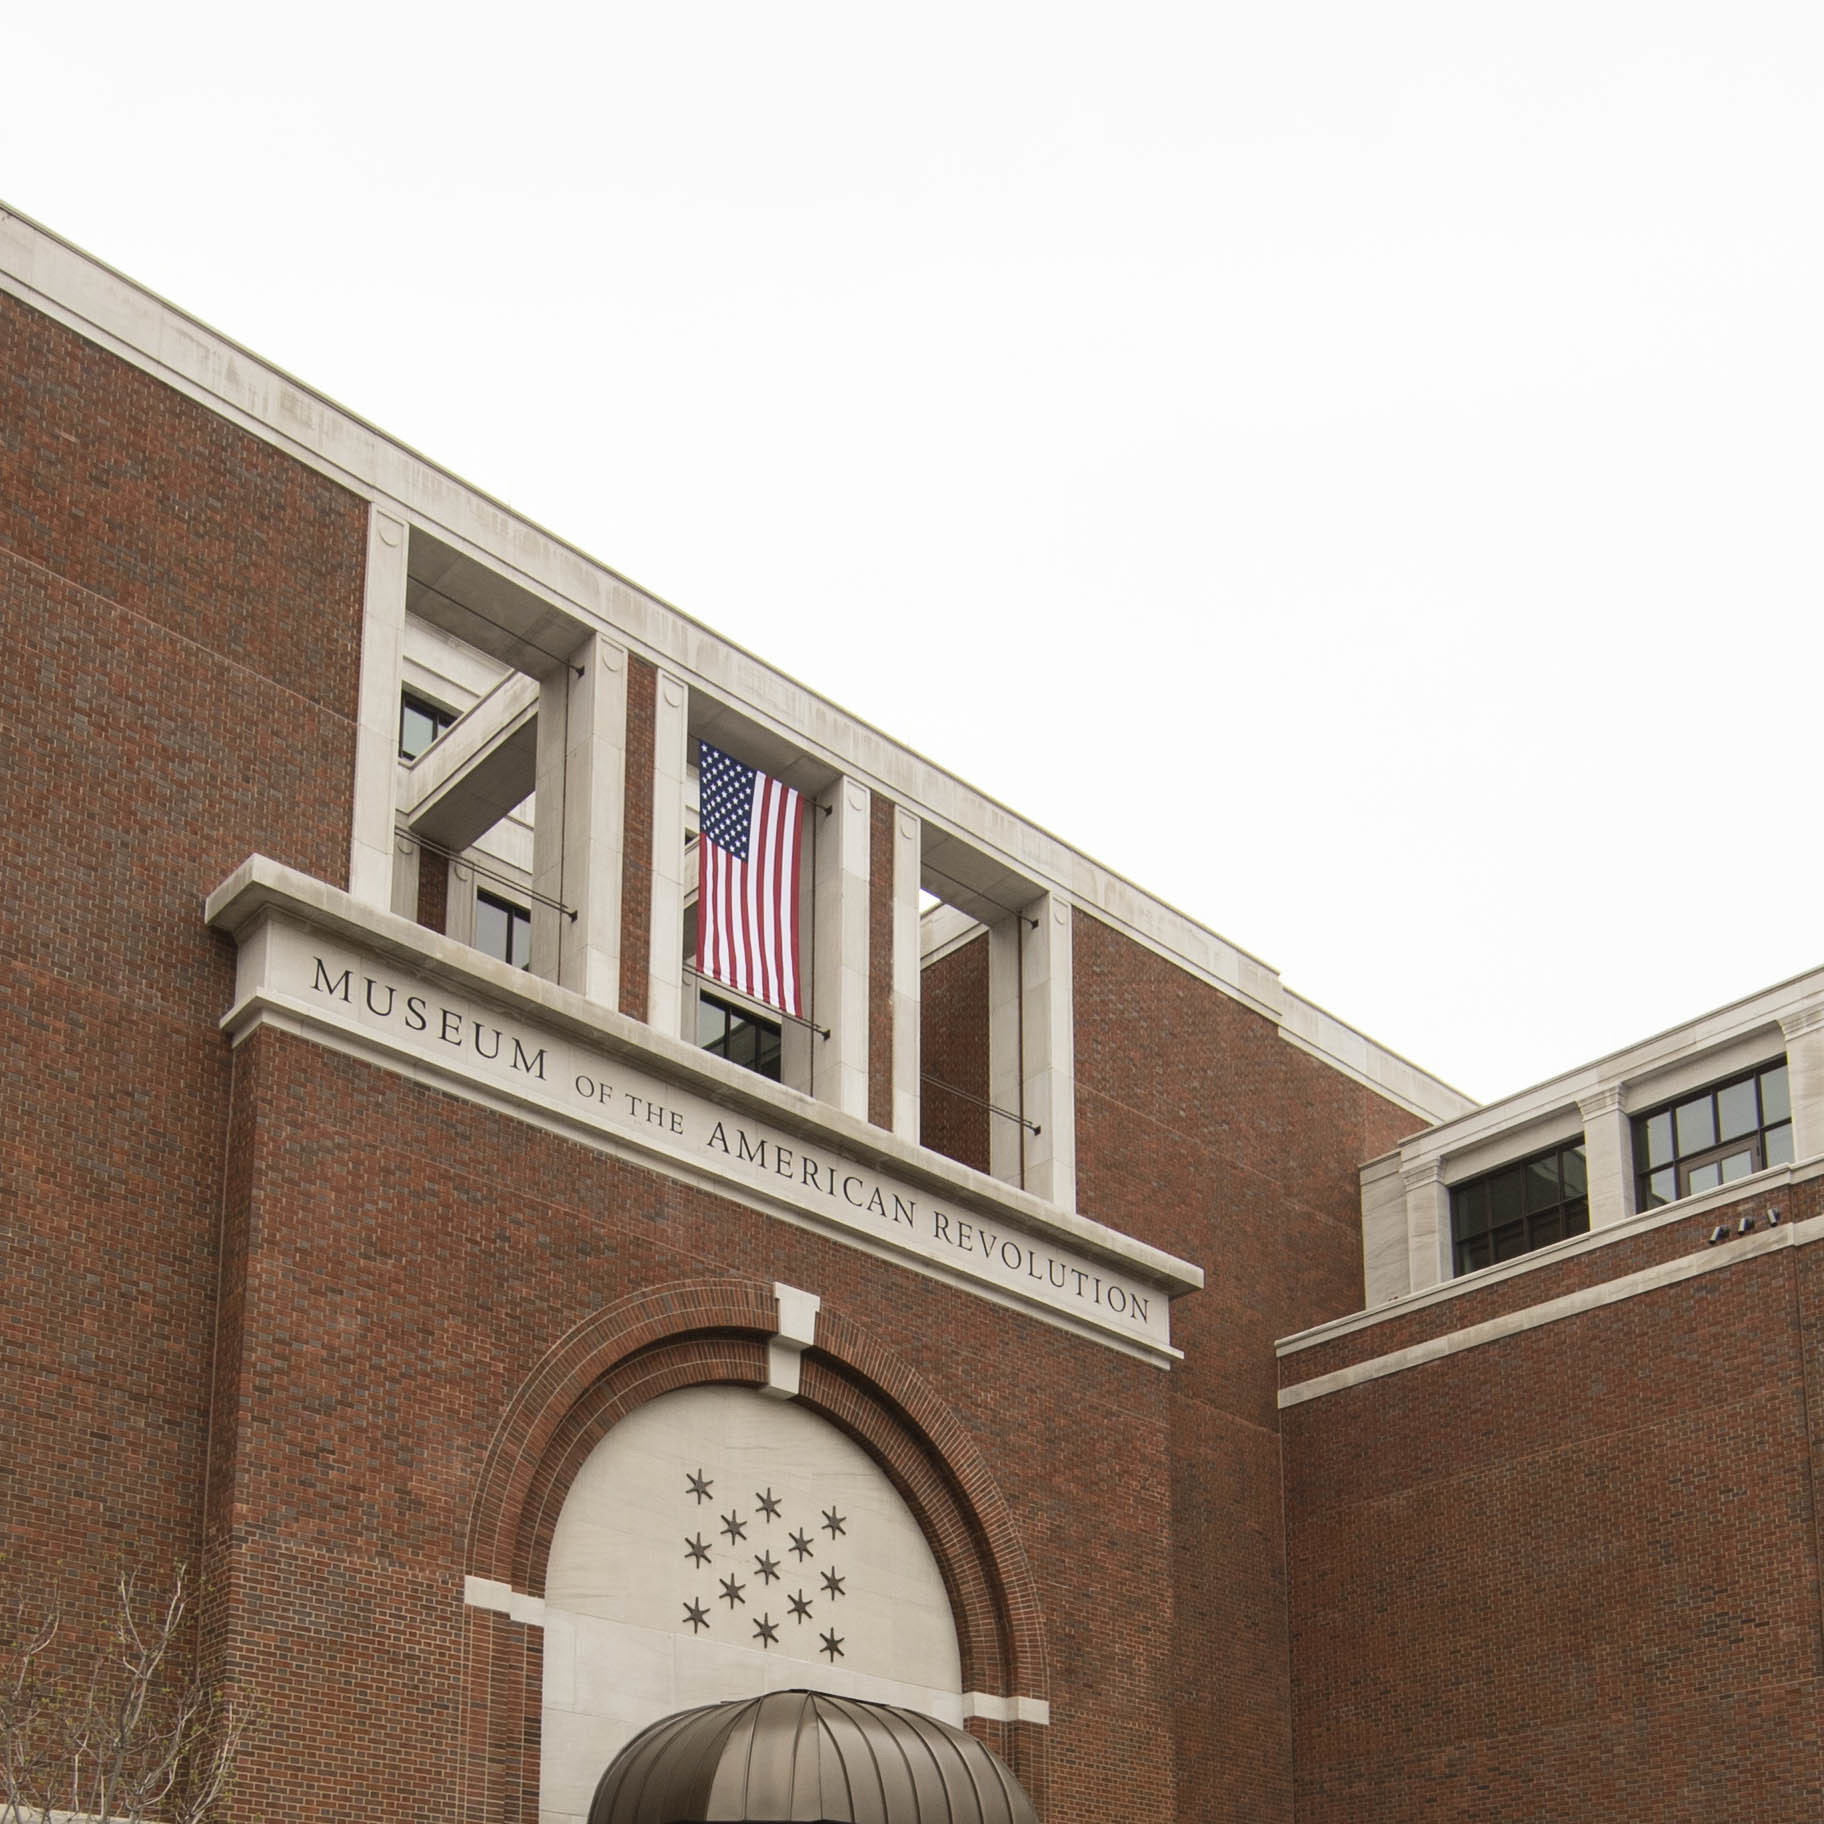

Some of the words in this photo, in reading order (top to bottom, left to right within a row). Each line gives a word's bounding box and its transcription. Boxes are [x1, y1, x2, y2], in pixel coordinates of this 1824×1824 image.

[312, 956, 549, 1082] MUSEUM
[576, 1072, 613, 1104] OF
[625, 1088, 686, 1136] THE
[705, 1120, 917, 1230] AMERICAN
[933, 1209, 1152, 1325] REVOLUTION
